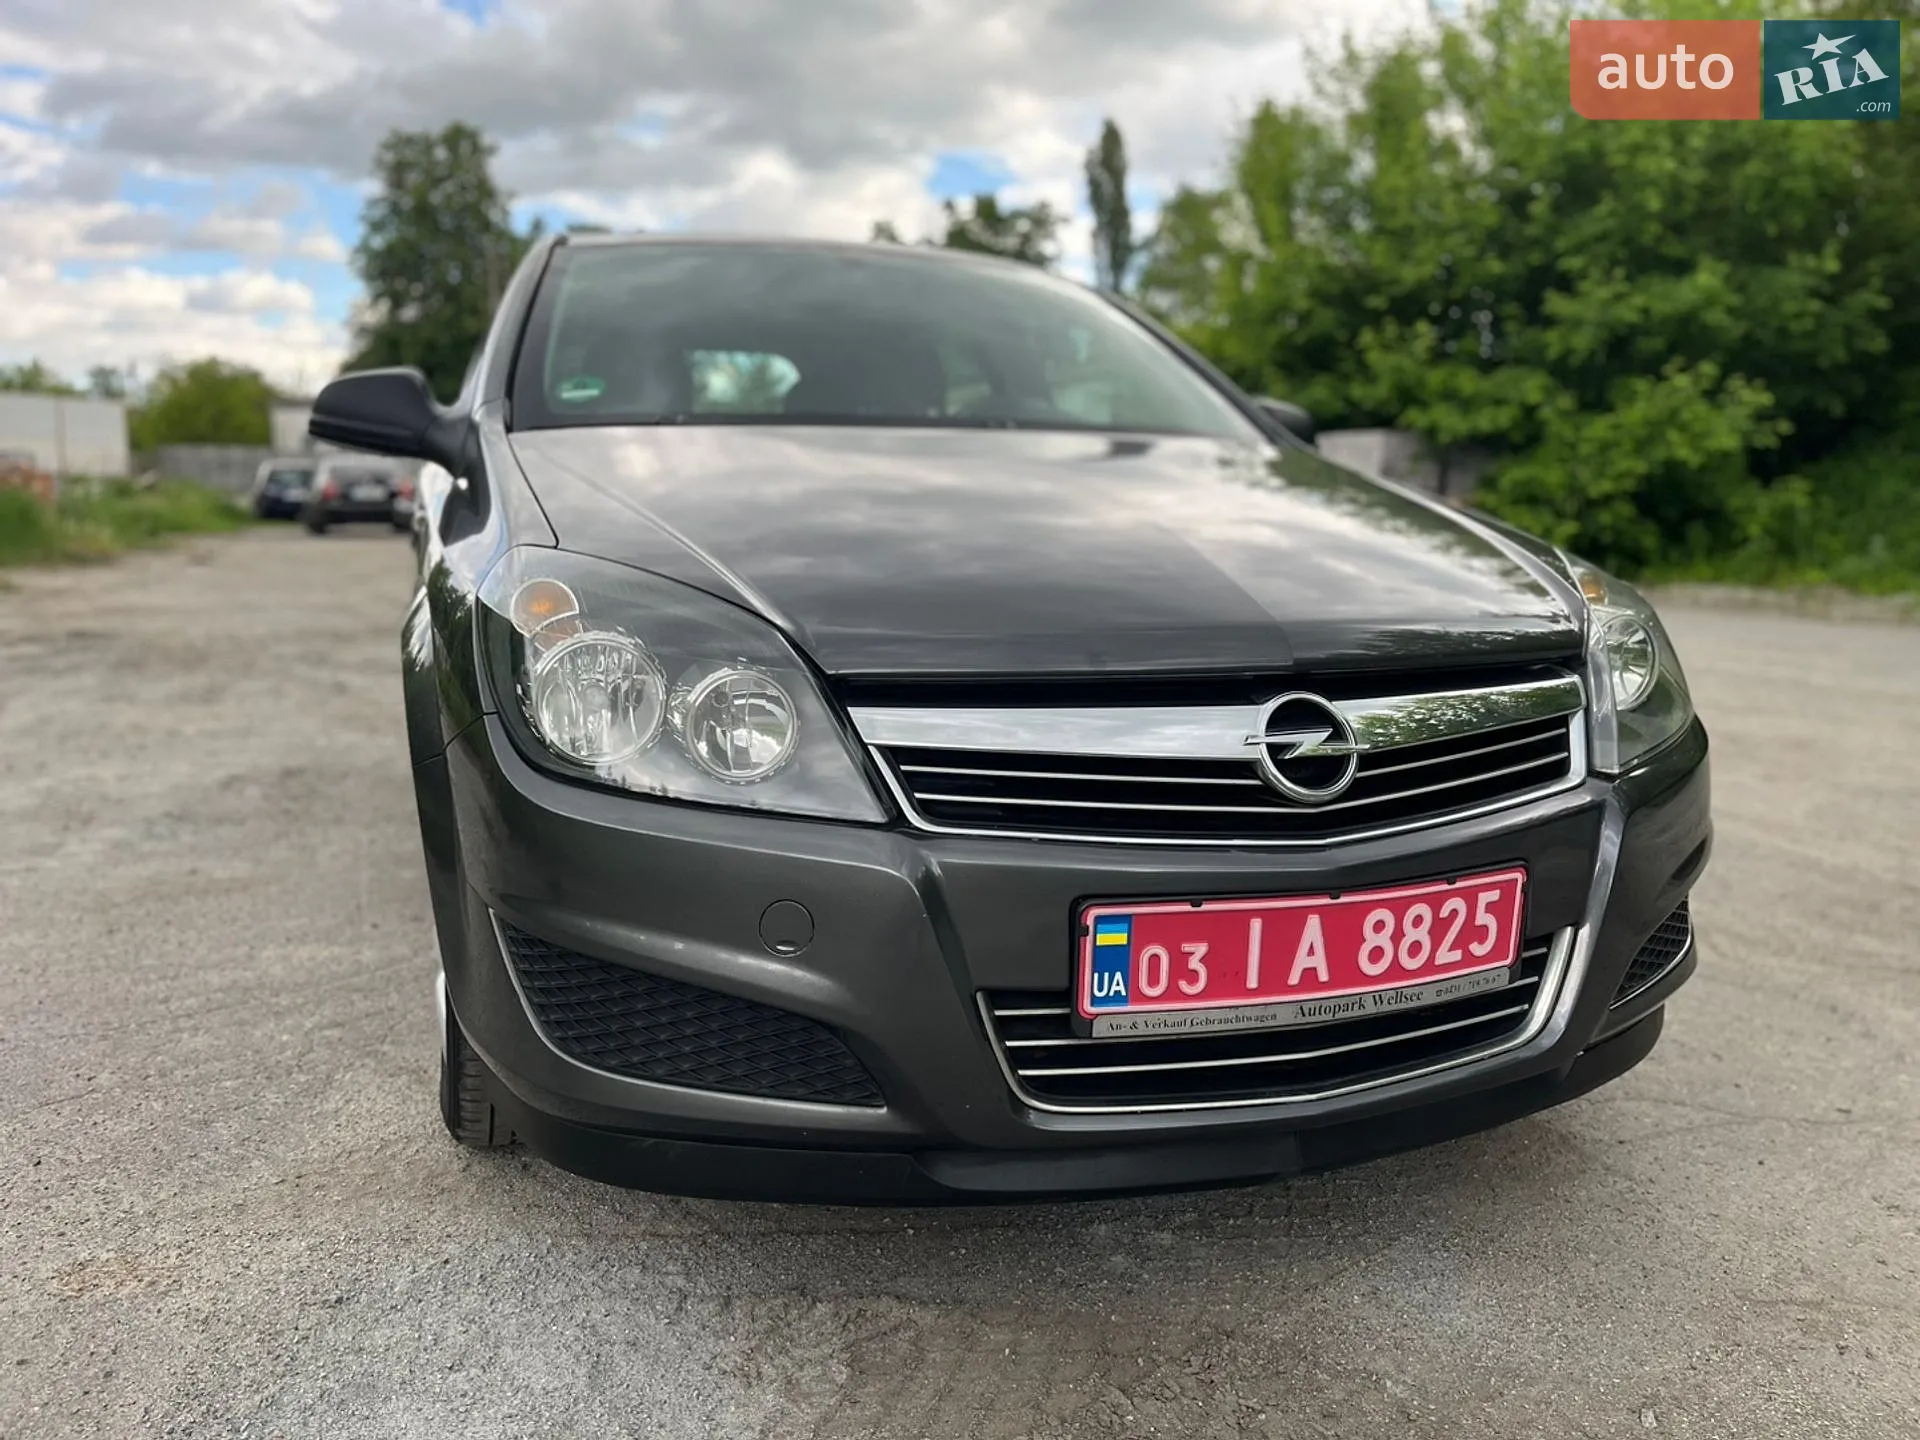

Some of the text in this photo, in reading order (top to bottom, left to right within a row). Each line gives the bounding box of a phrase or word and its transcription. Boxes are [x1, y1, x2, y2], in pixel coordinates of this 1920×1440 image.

[1138, 943, 1209, 997] 03
[1357, 889, 1501, 977] 8825
[1093, 970, 1127, 998] UA
[1144, 1017, 1189, 1030] Verkauf
[1190, 1012, 1277, 1028] Gebrauchtwagen
[1294, 996, 1367, 1019] Autopark
[1372, 989, 1424, 1010] Wellsee
